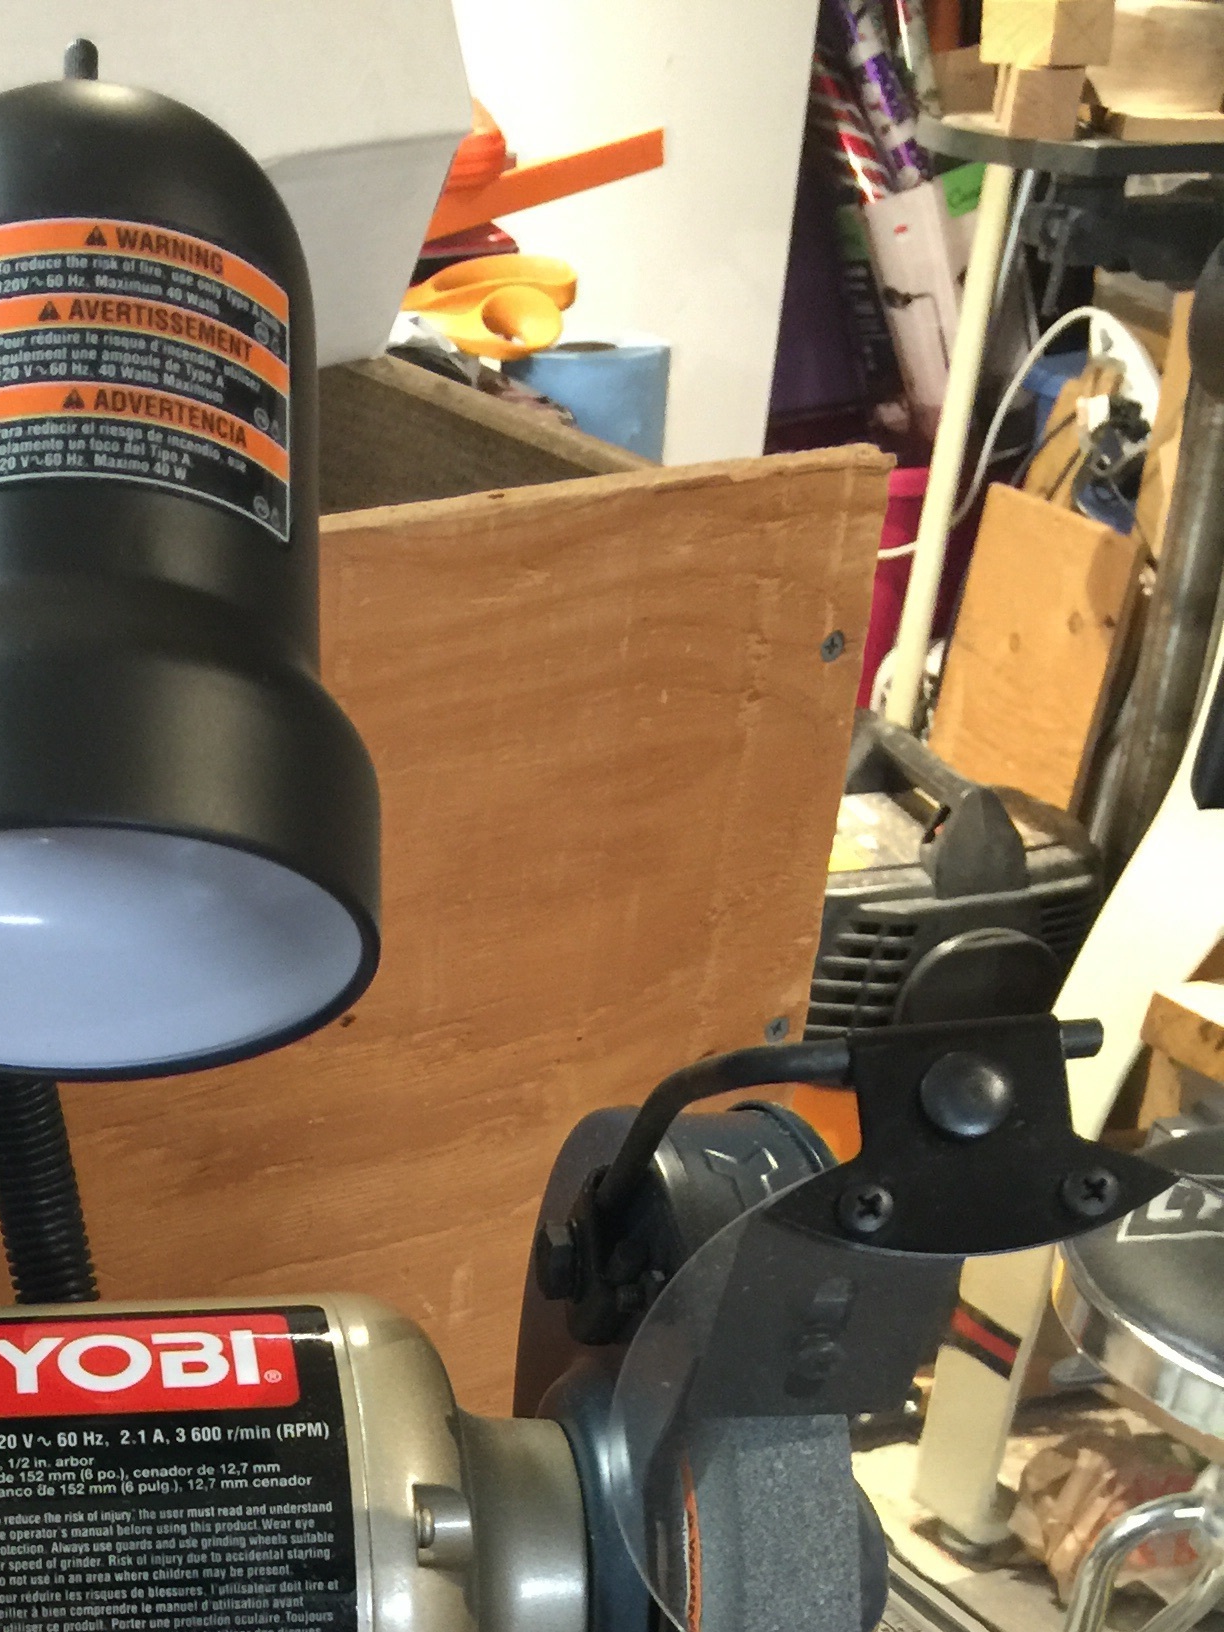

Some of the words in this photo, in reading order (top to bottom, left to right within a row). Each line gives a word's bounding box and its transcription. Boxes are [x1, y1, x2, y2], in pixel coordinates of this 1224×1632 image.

[116, 226, 223, 275] WARNING
[68, 298, 253, 363] AVERTISSEMENT
[94, 389, 247, 448] ADVERTENCIA
[57, 1432, 77, 1447] 60
[83, 1431, 110, 1447] Hz,
[120, 1429, 147, 1445] 2.1
[153, 1428, 171, 1444] A,
[176, 1427, 186, 1442] 3
[191, 1426, 221, 1442] 600
[227, 1425, 271, 1442] r/min
[276, 1420, 330, 1442] (RPM)
[8, 1458, 30, 1469] 1/2
[34, 1457, 51, 1468] in.
[55, 1456, 94, 1467] arbor
[20, 1471, 44, 1482] 152
[49, 1470, 76, 1481] mm
[80, 1468, 94, 1482] (6
[98, 1467, 129, 1481] po.),
[133, 1465, 192, 1479] cenador
[197, 1464, 215, 1476] de
[220, 1463, 249, 1476] 12,7
[253, 1463, 280, 1472] mm
[37, 1484, 55, 1496] de
[60, 1484, 85, 1495] 152
[89, 1483, 117, 1494] mm
[121, 1481, 134, 1495] (6
[138, 1479, 182, 1494] pulg.),
[187, 1477, 216, 1491] 12,7
[220, 1477, 248, 1488] mm
[253, 1475, 312, 1487] cenador
[4, 1514, 40, 1525] reduce
[44, 1513, 61, 1523] the
[65, 1511, 84, 1522] risk
[87, 1511, 98, 1521] of
[139, 1509, 156, 1520] the
[159, 1509, 184, 1519] user
[187, 1506, 215, 1518] must
[217, 1505, 242, 1516] read
[246, 1504, 266, 1515] and
[269, 1502, 332, 1514] understand
[10, 1527, 67, 1541] operator's
[71, 1526, 113, 1538] manual
[117, 1524, 152, 1536] before
[157, 1523, 187, 1535] using
[190, 1521, 212, 1533] this
[215, 1519, 260, 1533] product.
[261, 1518, 291, 1530] Wear
[295, 1518, 315, 1530] eye
[51, 1542, 90, 1555] Always
[93, 1542, 112, 1551] use
[116, 1539, 152, 1553] guards
[156, 1537, 175, 1549] and
[179, 1537, 198, 1548] use
[201, 1535, 246, 1549] grinding
[249, 1534, 288, 1545] wheels
[290, 1532, 334, 1544] suitable
[9, 1558, 42, 1572] speed
[46, 1558, 56, 1569] of
[61, 1556, 104, 1571] grinder.
[108, 1555, 132, 1566] Risk
[137, 1554, 147, 1565] of
[151, 1553, 183, 1566] injury
[187, 1552, 207, 1563] due
[211, 1552, 221, 1563] to
[226, 1549, 283, 1562] accidental
[9, 1575, 27, 1586] not
[31, 1575, 50, 1585] use
[54, 1573, 64, 1583] in
[68, 1574, 82, 1583] an
[86, 1573, 110, 1582] area
[115, 1571, 148, 1582] where
[152, 1568, 199, 1580] children
[203, 1569, 225, 1579] may
[230, 1566, 243, 1577] be
